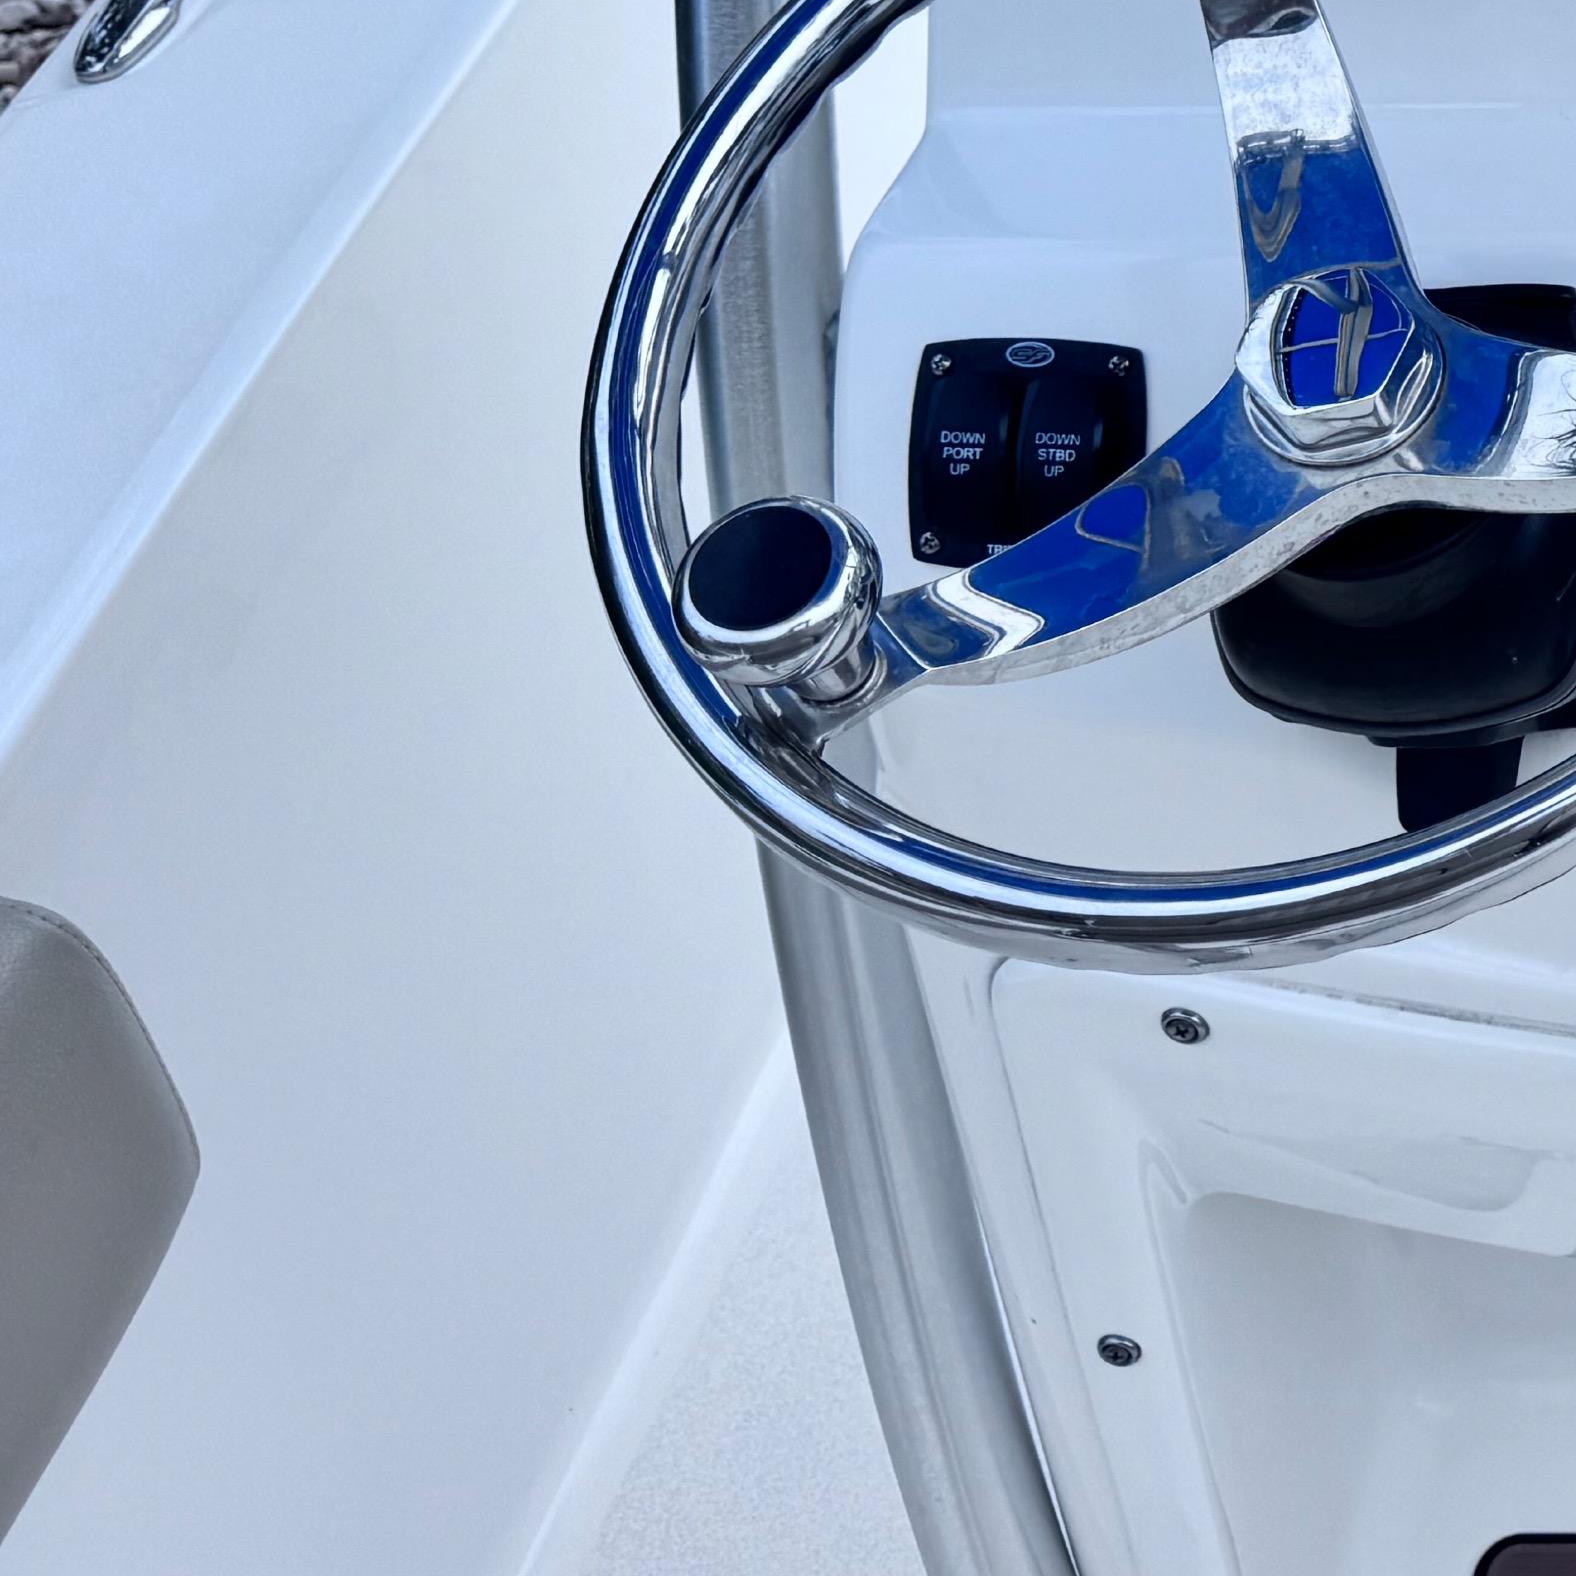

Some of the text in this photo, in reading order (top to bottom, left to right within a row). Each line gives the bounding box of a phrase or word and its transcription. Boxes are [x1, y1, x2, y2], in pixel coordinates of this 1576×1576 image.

[940, 430, 985, 444] DOWN
[1035, 432, 1080, 445] DOWN
[942, 446, 983, 460] PORT
[1038, 448, 1076, 461] STBD
[949, 462, 970, 475] UP
[1044, 464, 1064, 477] UP
